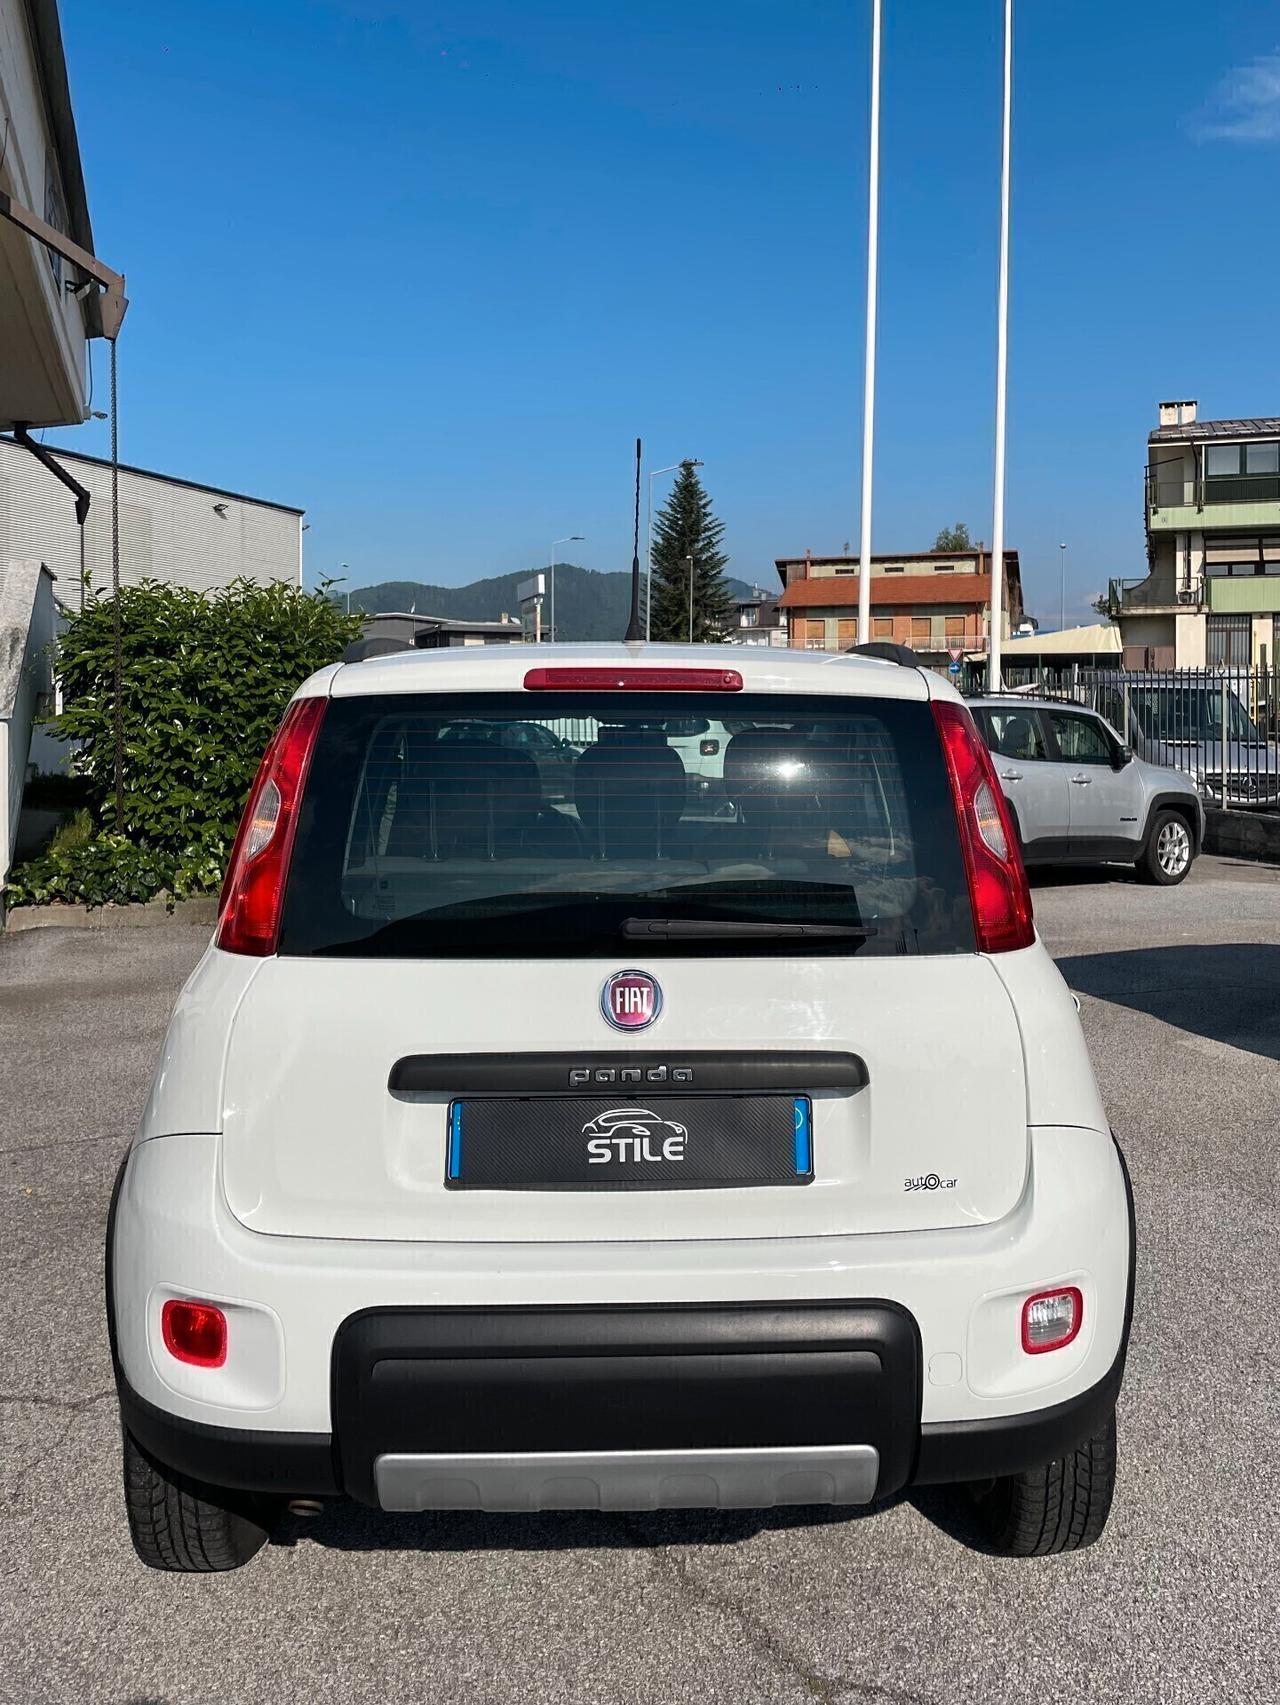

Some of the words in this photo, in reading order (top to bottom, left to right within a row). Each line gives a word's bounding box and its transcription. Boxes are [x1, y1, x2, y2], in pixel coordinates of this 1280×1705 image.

[615, 987, 650, 1014] FIAT
[569, 1065, 693, 1087] panda
[587, 1136, 684, 1163] STILE
